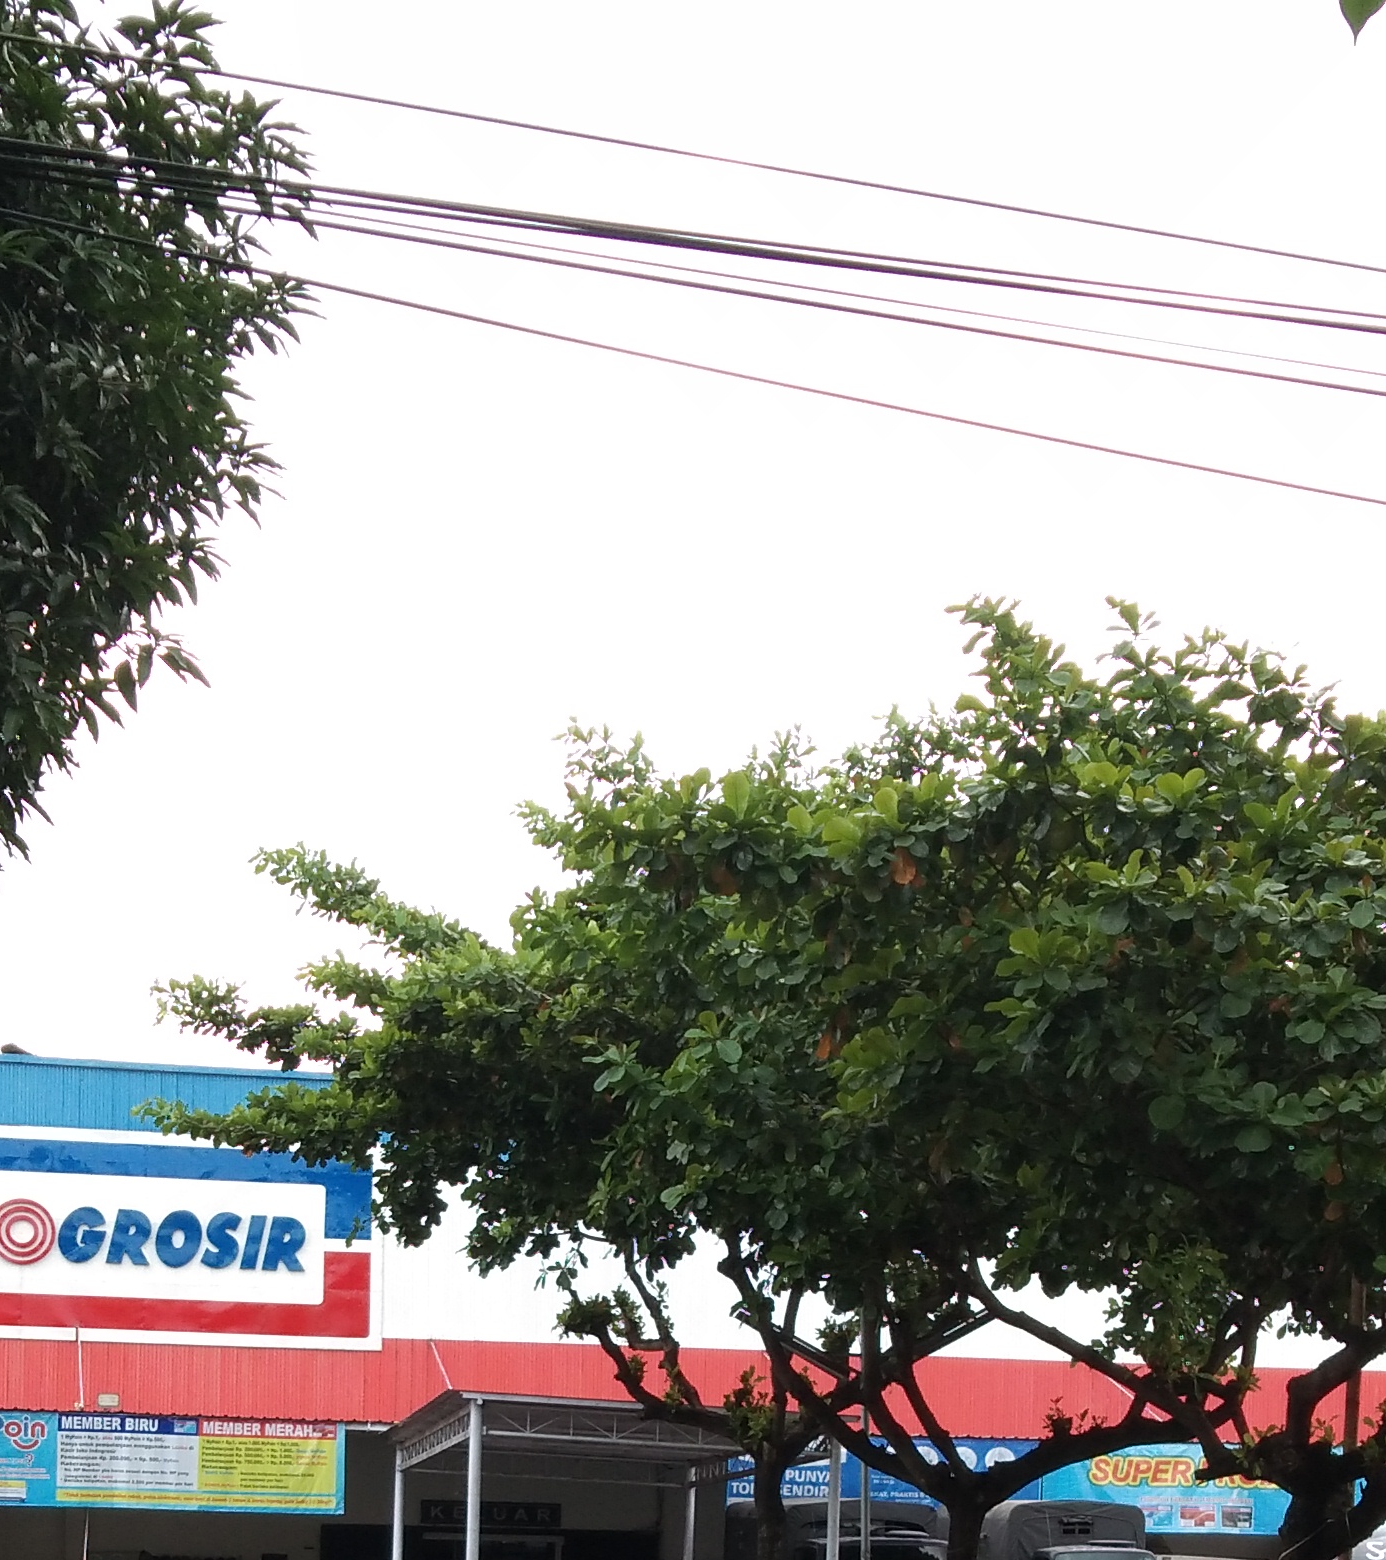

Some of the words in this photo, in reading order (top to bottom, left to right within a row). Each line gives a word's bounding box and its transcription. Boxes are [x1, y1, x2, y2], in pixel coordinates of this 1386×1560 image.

[61, 1416, 121, 1430] MEMBER
[125, 1418, 159, 1432] BIRU
[203, 1421, 261, 1436] MEMBER
[265, 1423, 313, 1437] MERAH
[1090, 1456, 1194, 1486] SUPER
[430, 1505, 551, 1521] KEUAR
